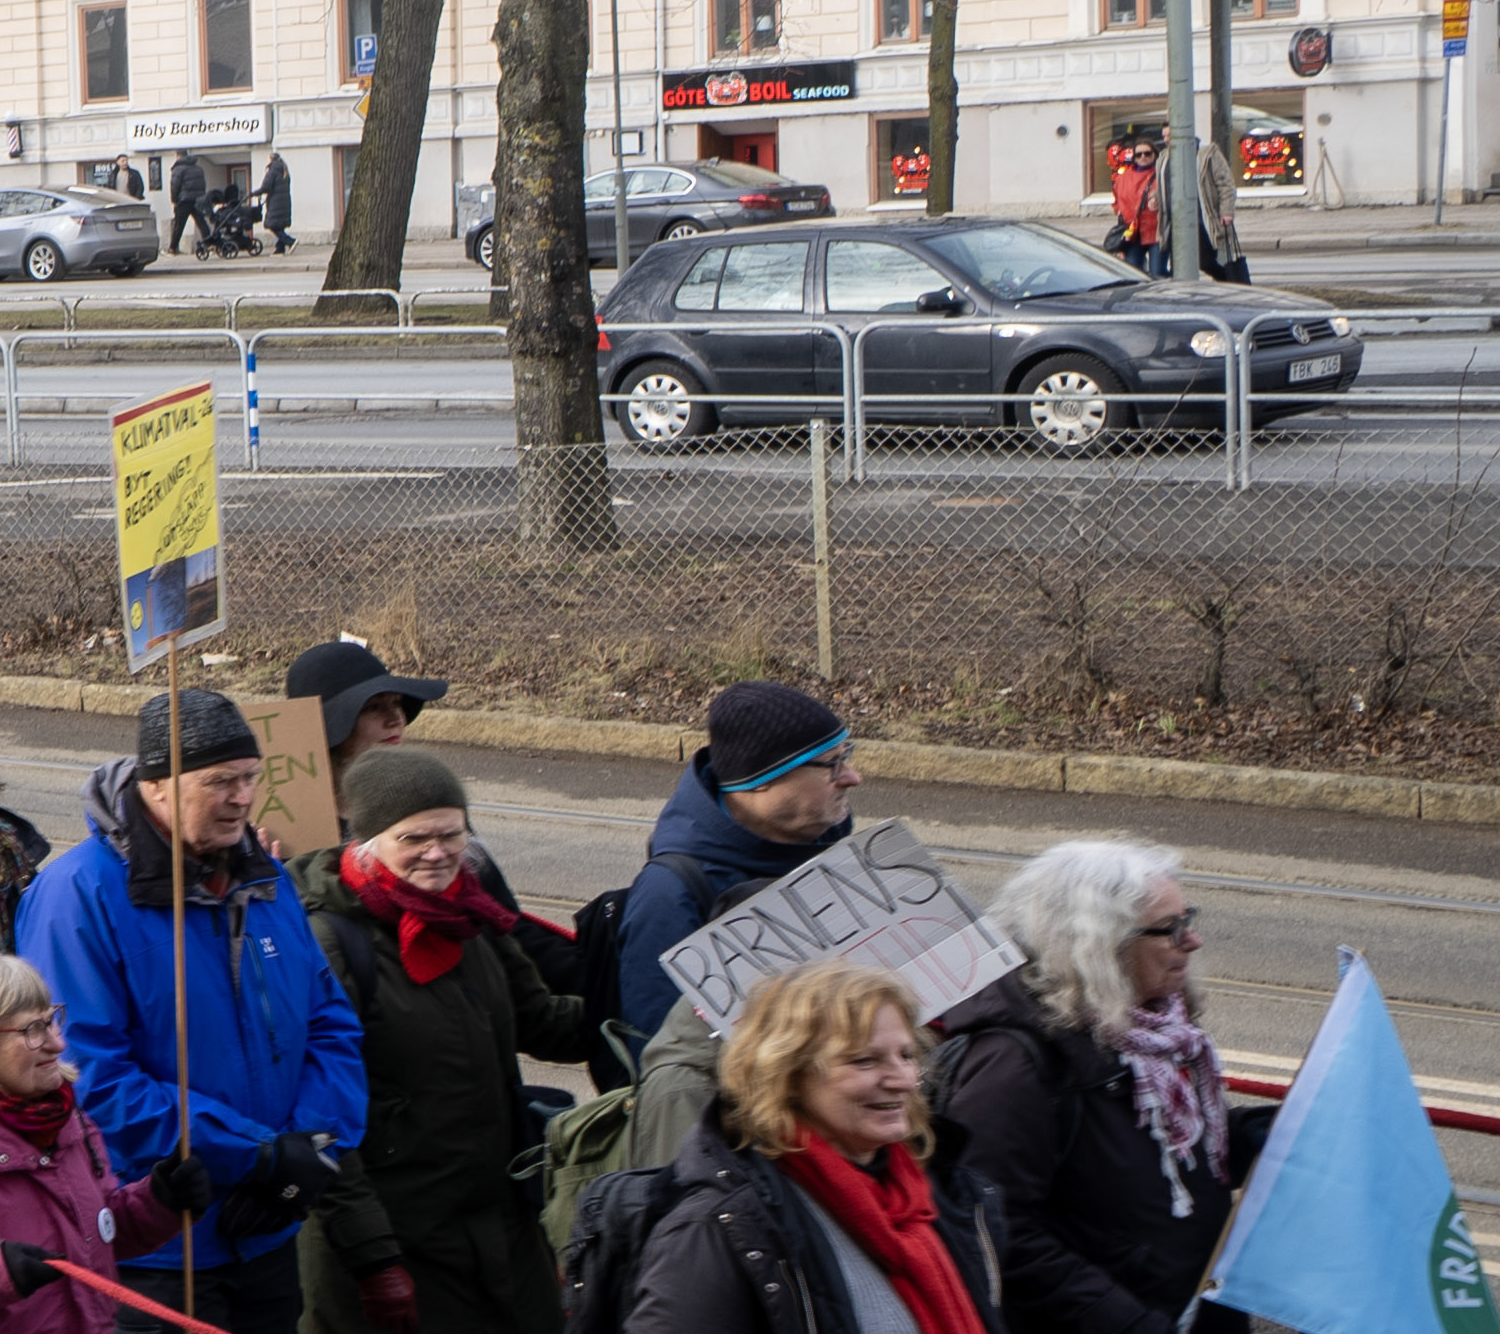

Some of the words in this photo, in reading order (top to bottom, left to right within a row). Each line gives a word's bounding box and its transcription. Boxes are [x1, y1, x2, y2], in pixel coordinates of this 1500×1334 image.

[361, 38, 373, 60] P
[750, 80, 791, 102] BOIL
[793, 84, 850, 101] SEAFOOD
[133, 124, 166, 140] Holy
[170, 116, 260, 136] Barbershop
[124, 469, 152, 500] BYT
[668, 823, 944, 1018] BARNENS
